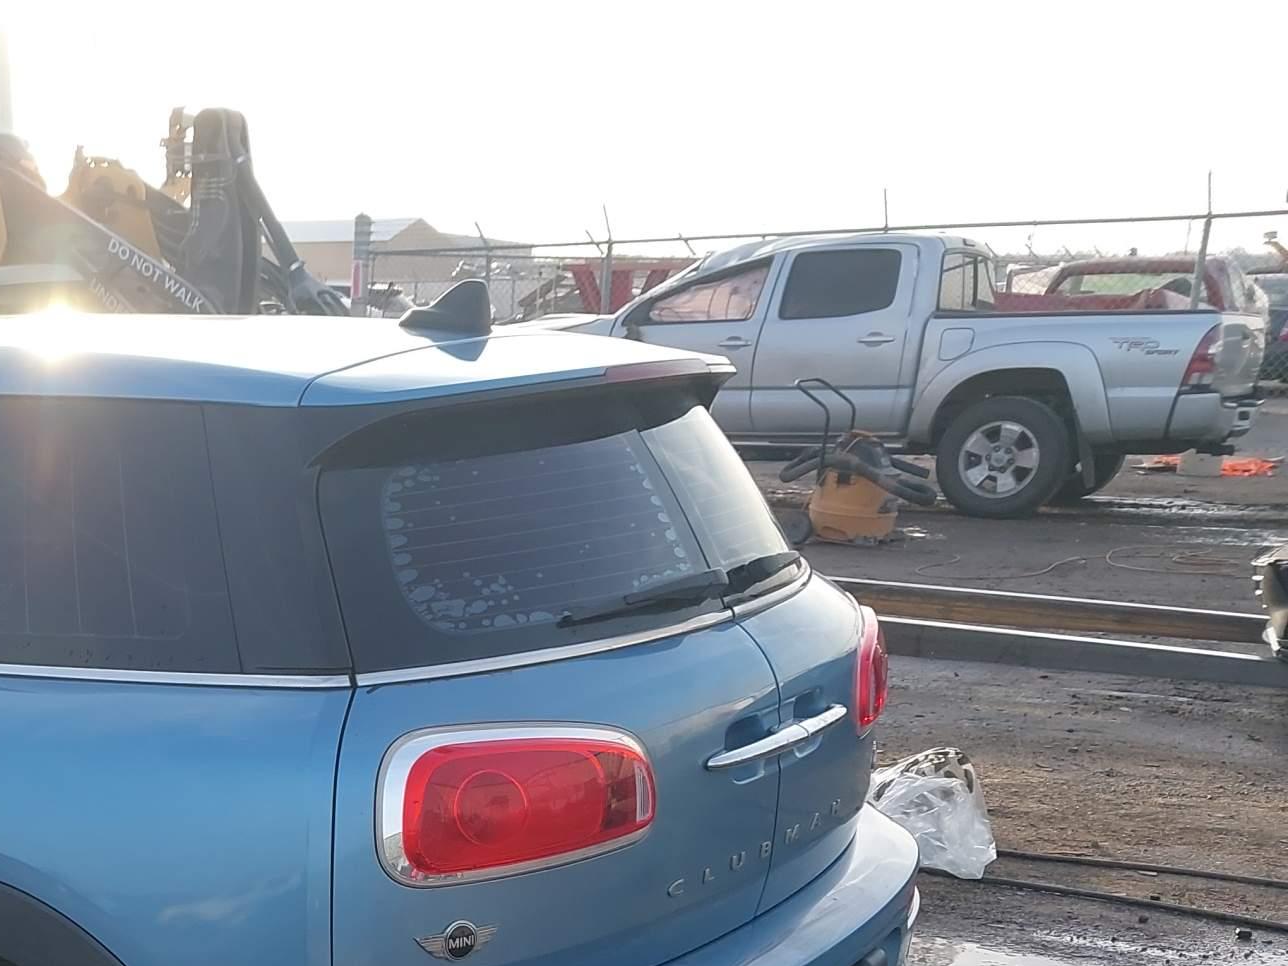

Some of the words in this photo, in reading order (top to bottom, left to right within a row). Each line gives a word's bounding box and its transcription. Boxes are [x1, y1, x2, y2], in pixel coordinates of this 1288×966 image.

[108, 238, 129, 260] DO
[131, 254, 163, 282] NOT
[164, 275, 203, 313] WALK
[448, 934, 475, 950] MINI
